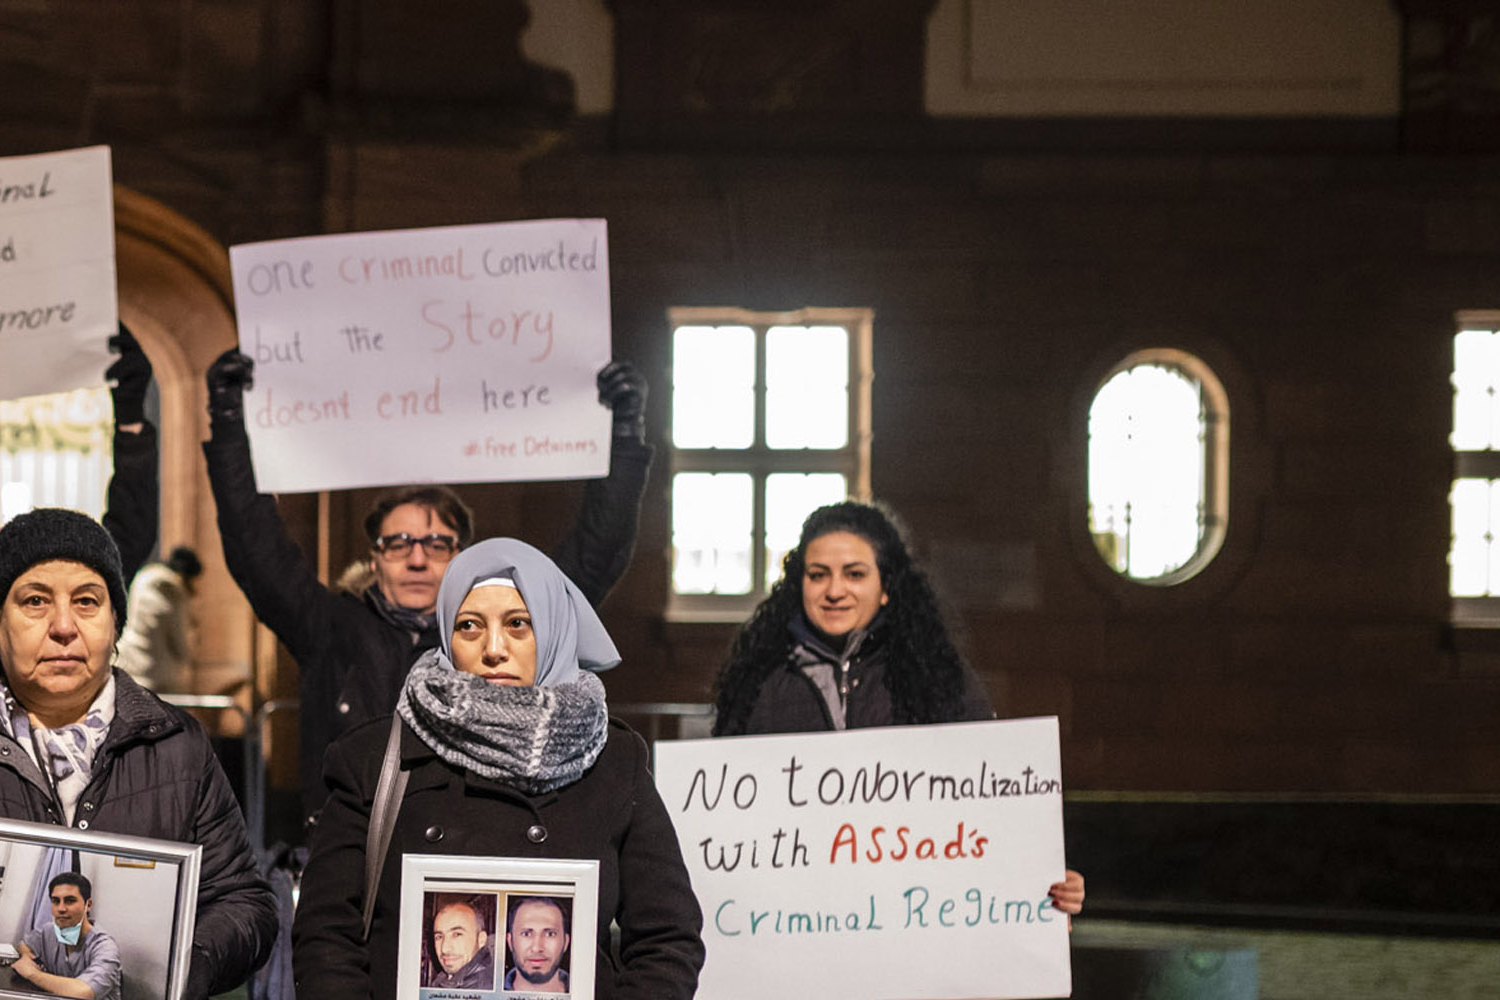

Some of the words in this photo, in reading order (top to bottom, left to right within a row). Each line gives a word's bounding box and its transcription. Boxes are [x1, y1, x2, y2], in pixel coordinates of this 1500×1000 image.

[482, 237, 598, 278] Convicted
[255, 324, 305, 366] but
[420, 299, 554, 363] Story
[376, 377, 444, 420] end
[481, 380, 551, 413] here
[715, 895, 883, 938] Criminal
[904, 886, 1055, 930] Regime
